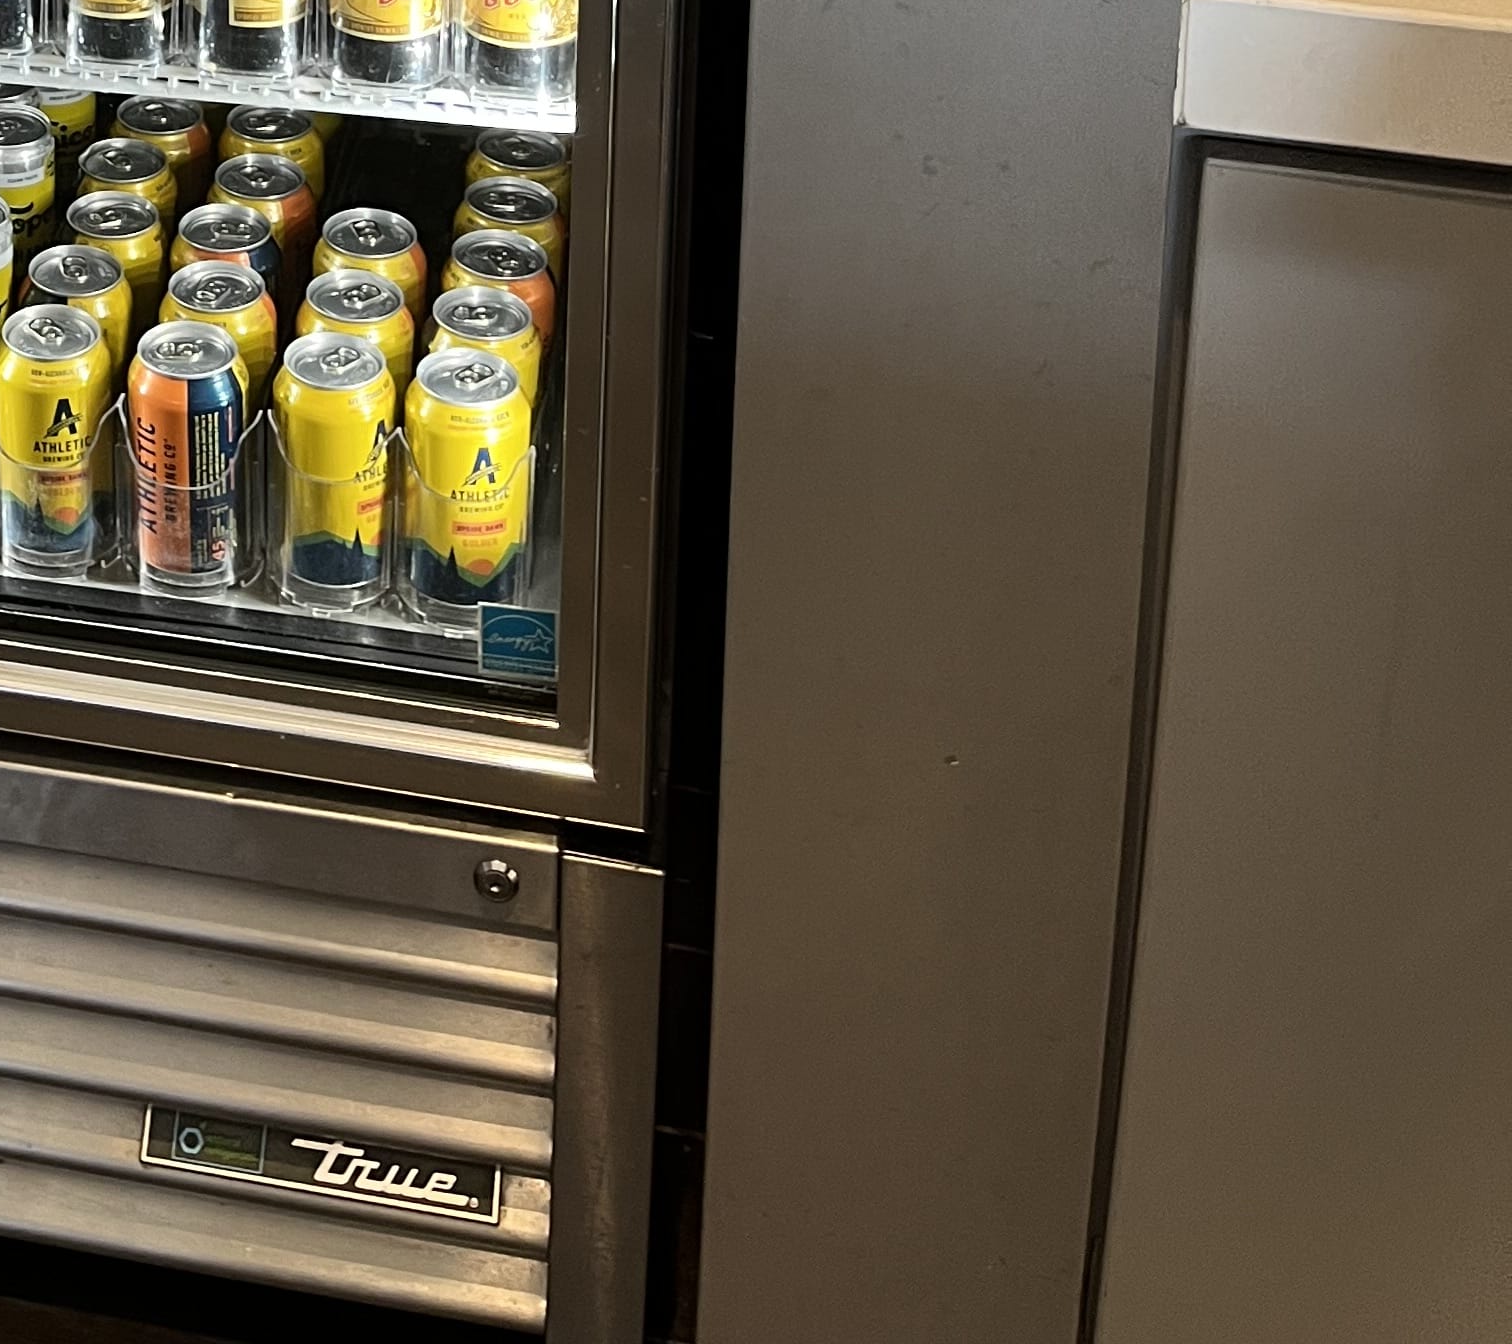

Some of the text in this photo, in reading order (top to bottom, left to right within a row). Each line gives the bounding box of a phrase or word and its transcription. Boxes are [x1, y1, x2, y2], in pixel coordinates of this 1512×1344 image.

[33, 435, 92, 453] ATHLETIC
[136, 416, 158, 535] ATHLETIC
[163, 462, 178, 524] BREWING
[450, 487, 510, 502] ATHLETIC
[291, 1137, 471, 1207] true
